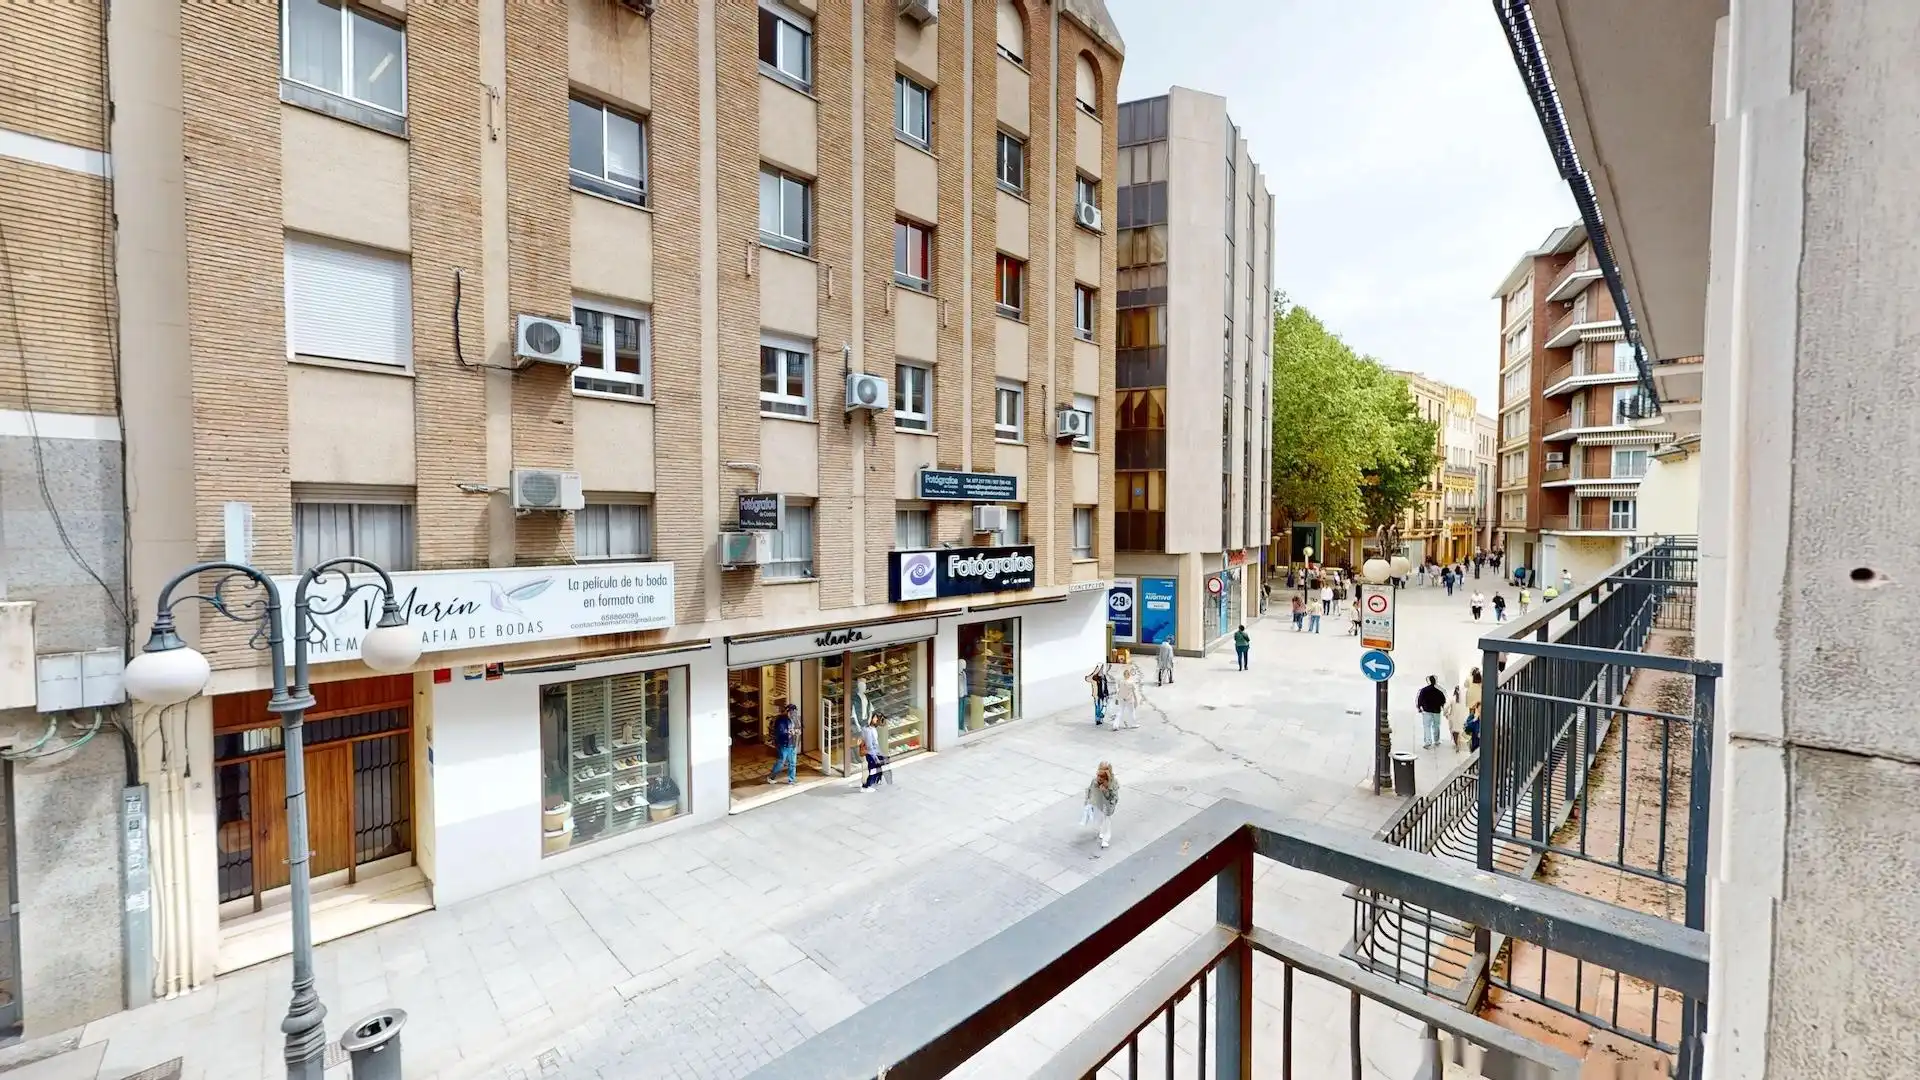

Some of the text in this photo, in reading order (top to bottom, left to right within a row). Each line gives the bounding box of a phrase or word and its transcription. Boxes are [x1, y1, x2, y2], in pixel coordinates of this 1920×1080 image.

[947, 551, 1034, 580] Fotógrafos
[568, 573, 668, 592] La película de tu boda
[583, 592, 655, 608] en formato cine
[469, 626, 486, 640] DE
[496, 620, 544, 637] BODAS
[815, 627, 872, 647] ulanka
